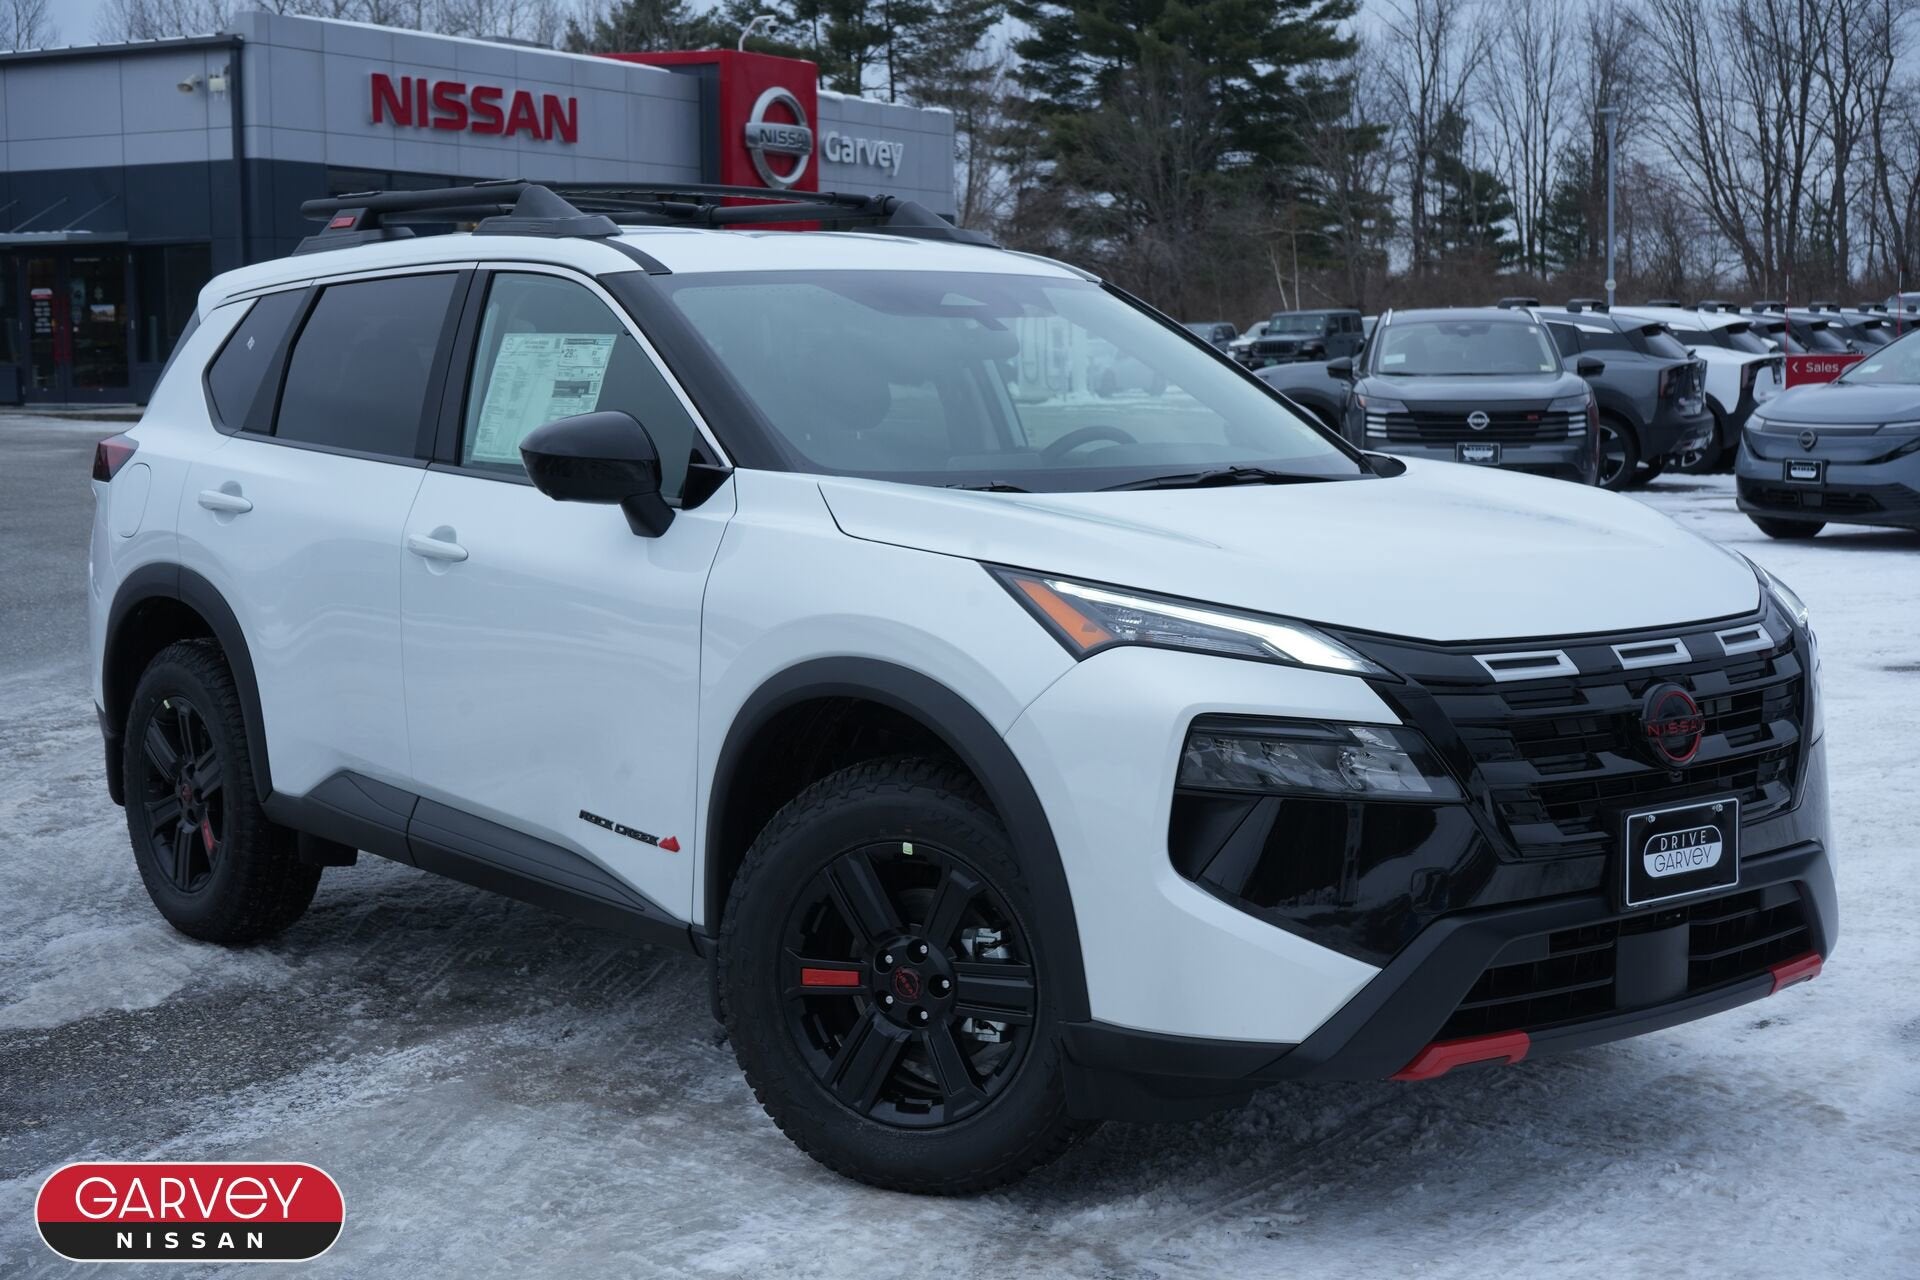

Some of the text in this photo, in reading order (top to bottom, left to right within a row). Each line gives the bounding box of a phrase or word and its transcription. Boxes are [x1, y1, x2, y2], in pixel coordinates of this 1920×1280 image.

[371, 73, 577, 143] NISSAN
[825, 131, 904, 176] Garvey
[1805, 361, 1840, 373] Sales
[579, 809, 615, 831] ROCK
[1660, 830, 1707, 851] DRIVE
[1654, 845, 1712, 873] GARVEY
